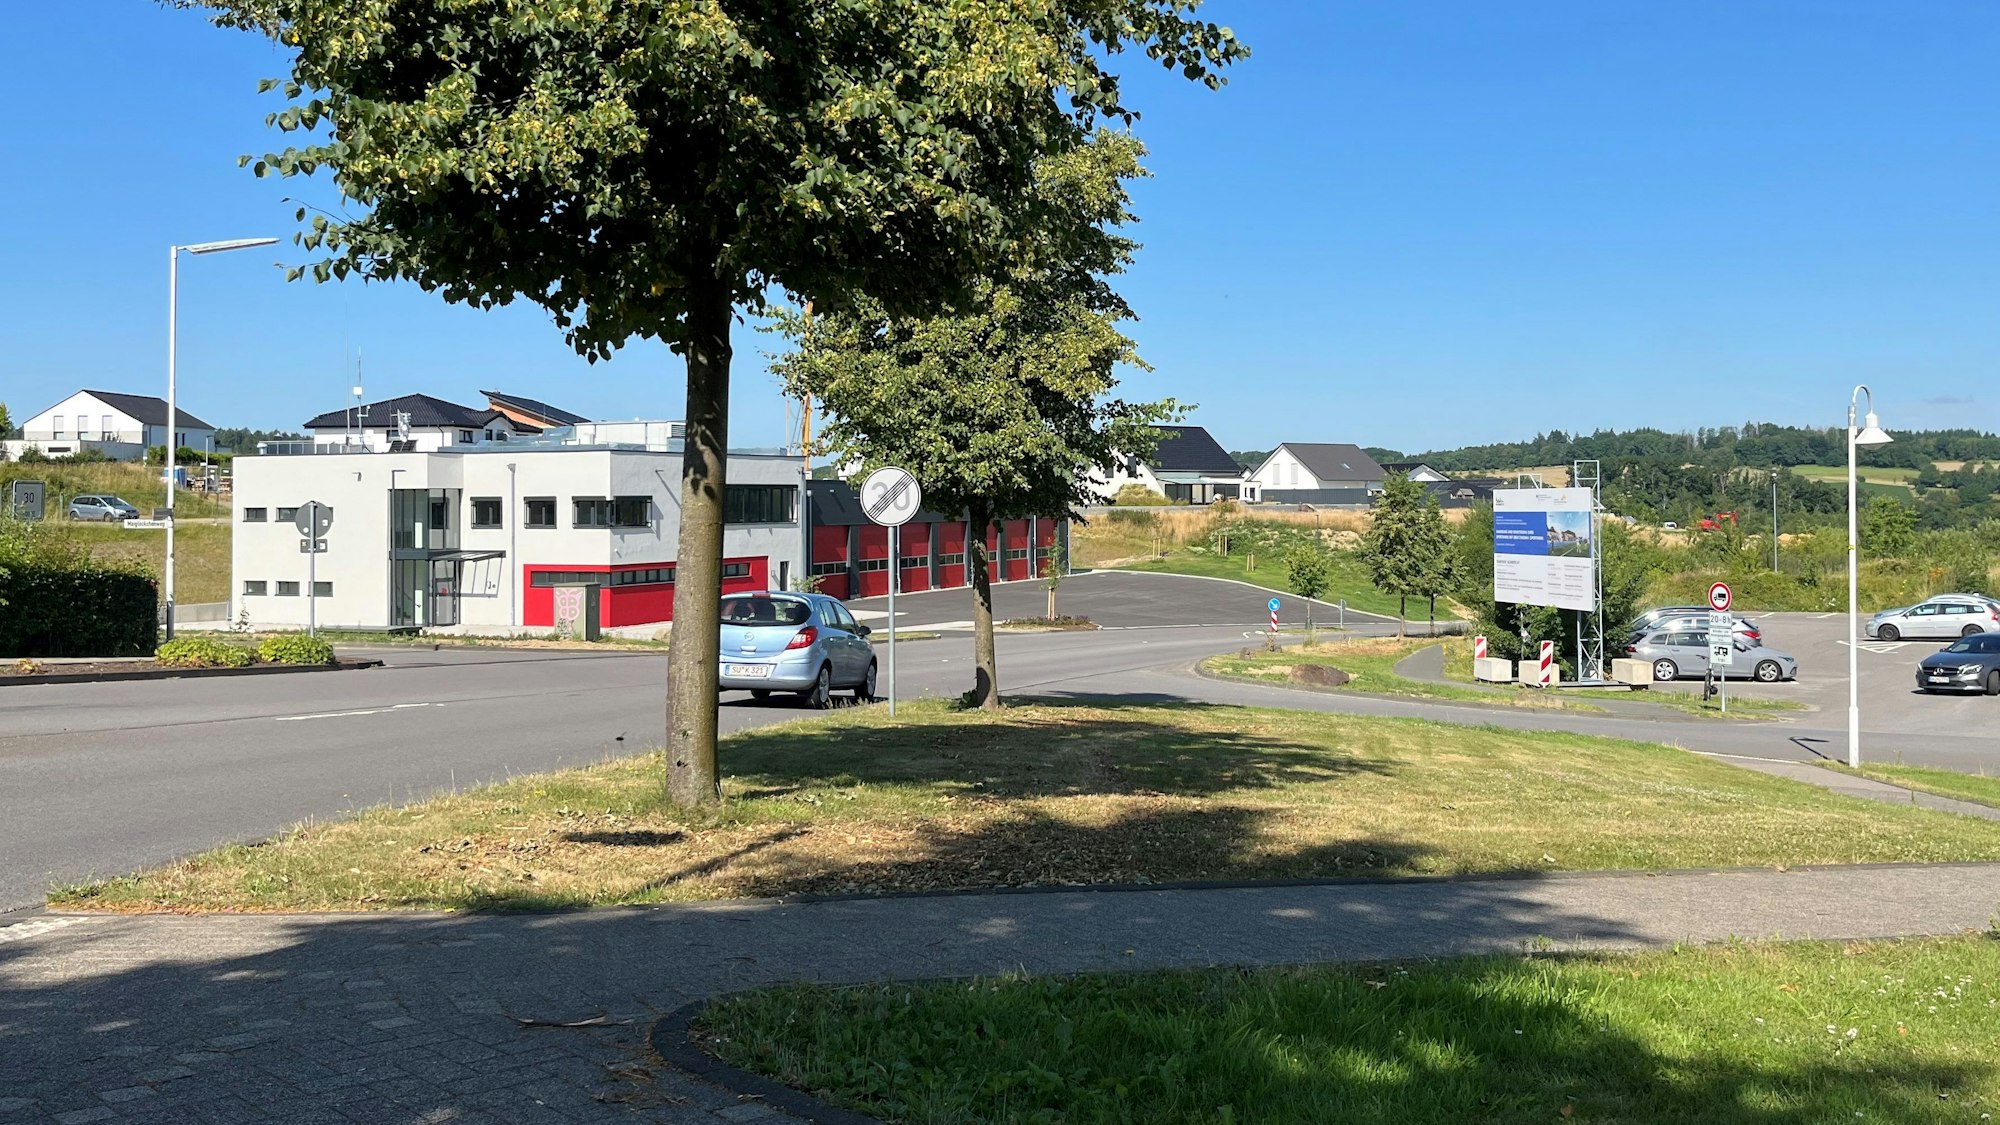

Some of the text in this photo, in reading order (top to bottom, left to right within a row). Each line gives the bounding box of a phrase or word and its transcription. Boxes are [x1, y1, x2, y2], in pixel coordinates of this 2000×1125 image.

[23, 492, 35, 503] 30
[871, 481, 910, 511] 30
[751, 666, 764, 674] 321
